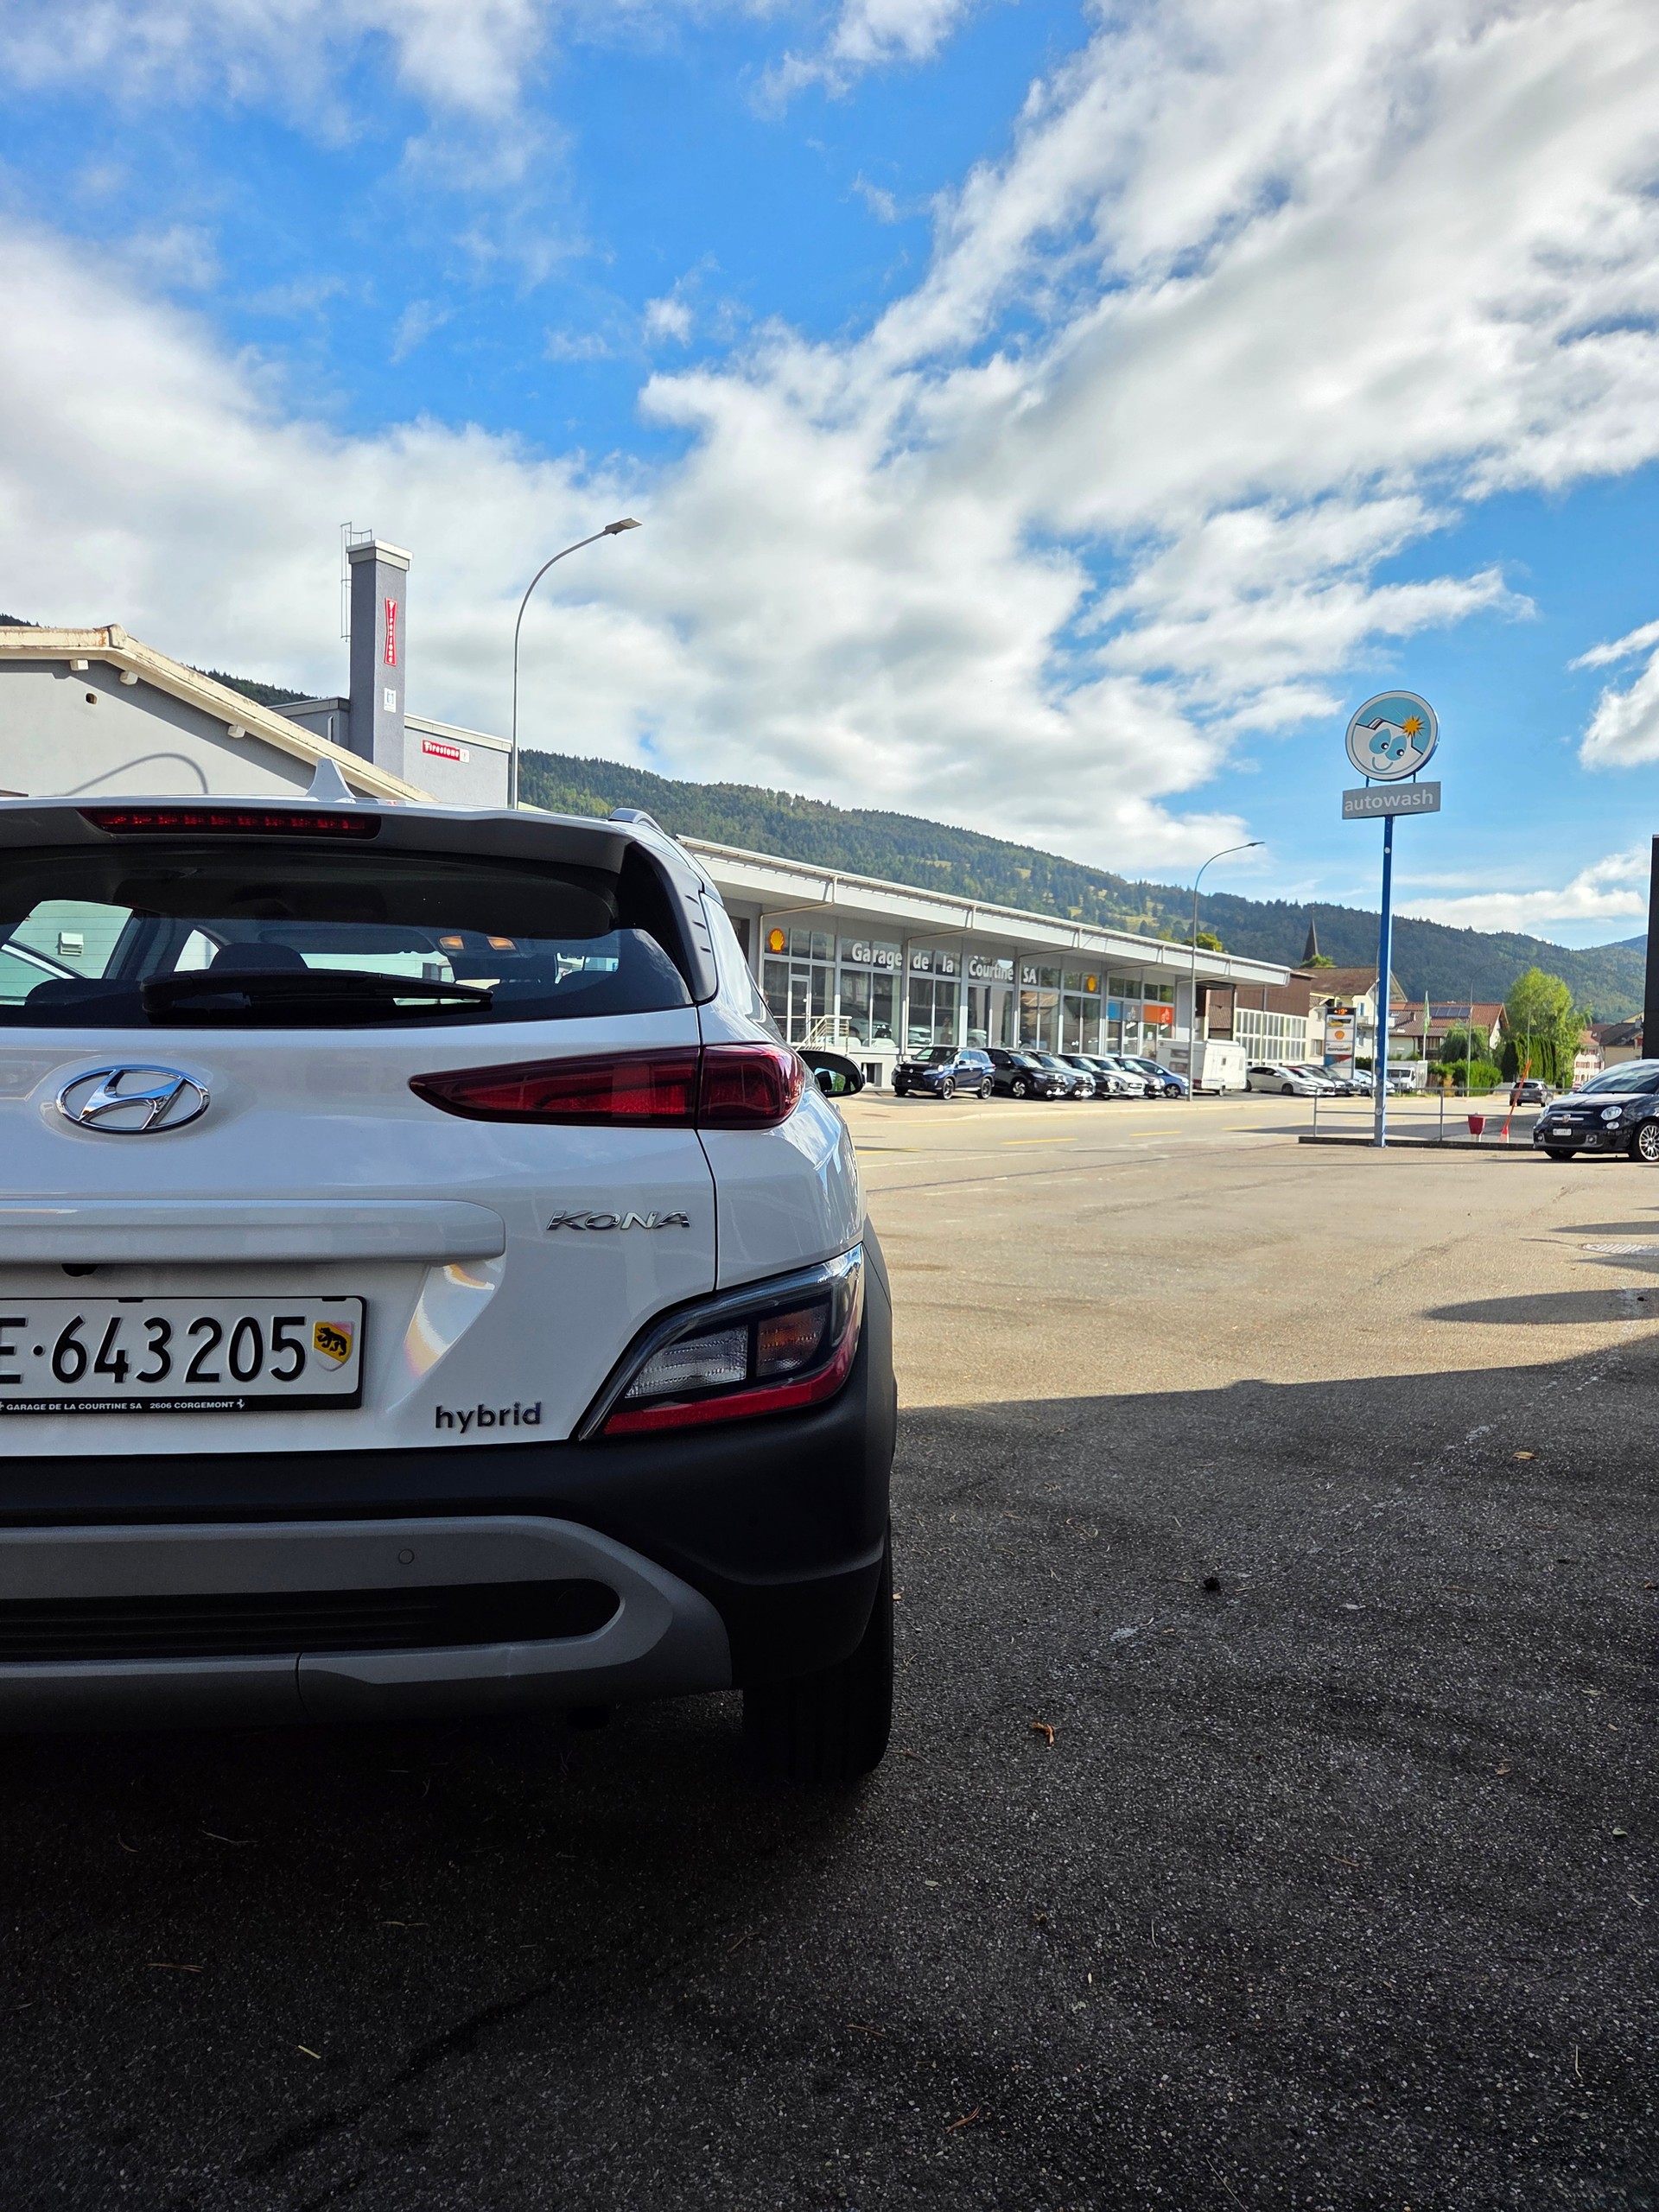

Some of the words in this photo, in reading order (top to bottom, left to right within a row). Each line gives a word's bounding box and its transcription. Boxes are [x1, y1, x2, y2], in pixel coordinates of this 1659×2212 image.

[423, 741, 460, 758] Firestone
[1344, 789, 1433, 812] autowash
[851, 942, 903, 971] Garage
[912, 952, 930, 970] de
[942, 956, 954, 974] la
[969, 958, 1014, 981] Courtine
[1023, 967, 1037, 984] SA
[546, 1210, 690, 1230] KONA
[435, 1402, 542, 1433] hybrid
